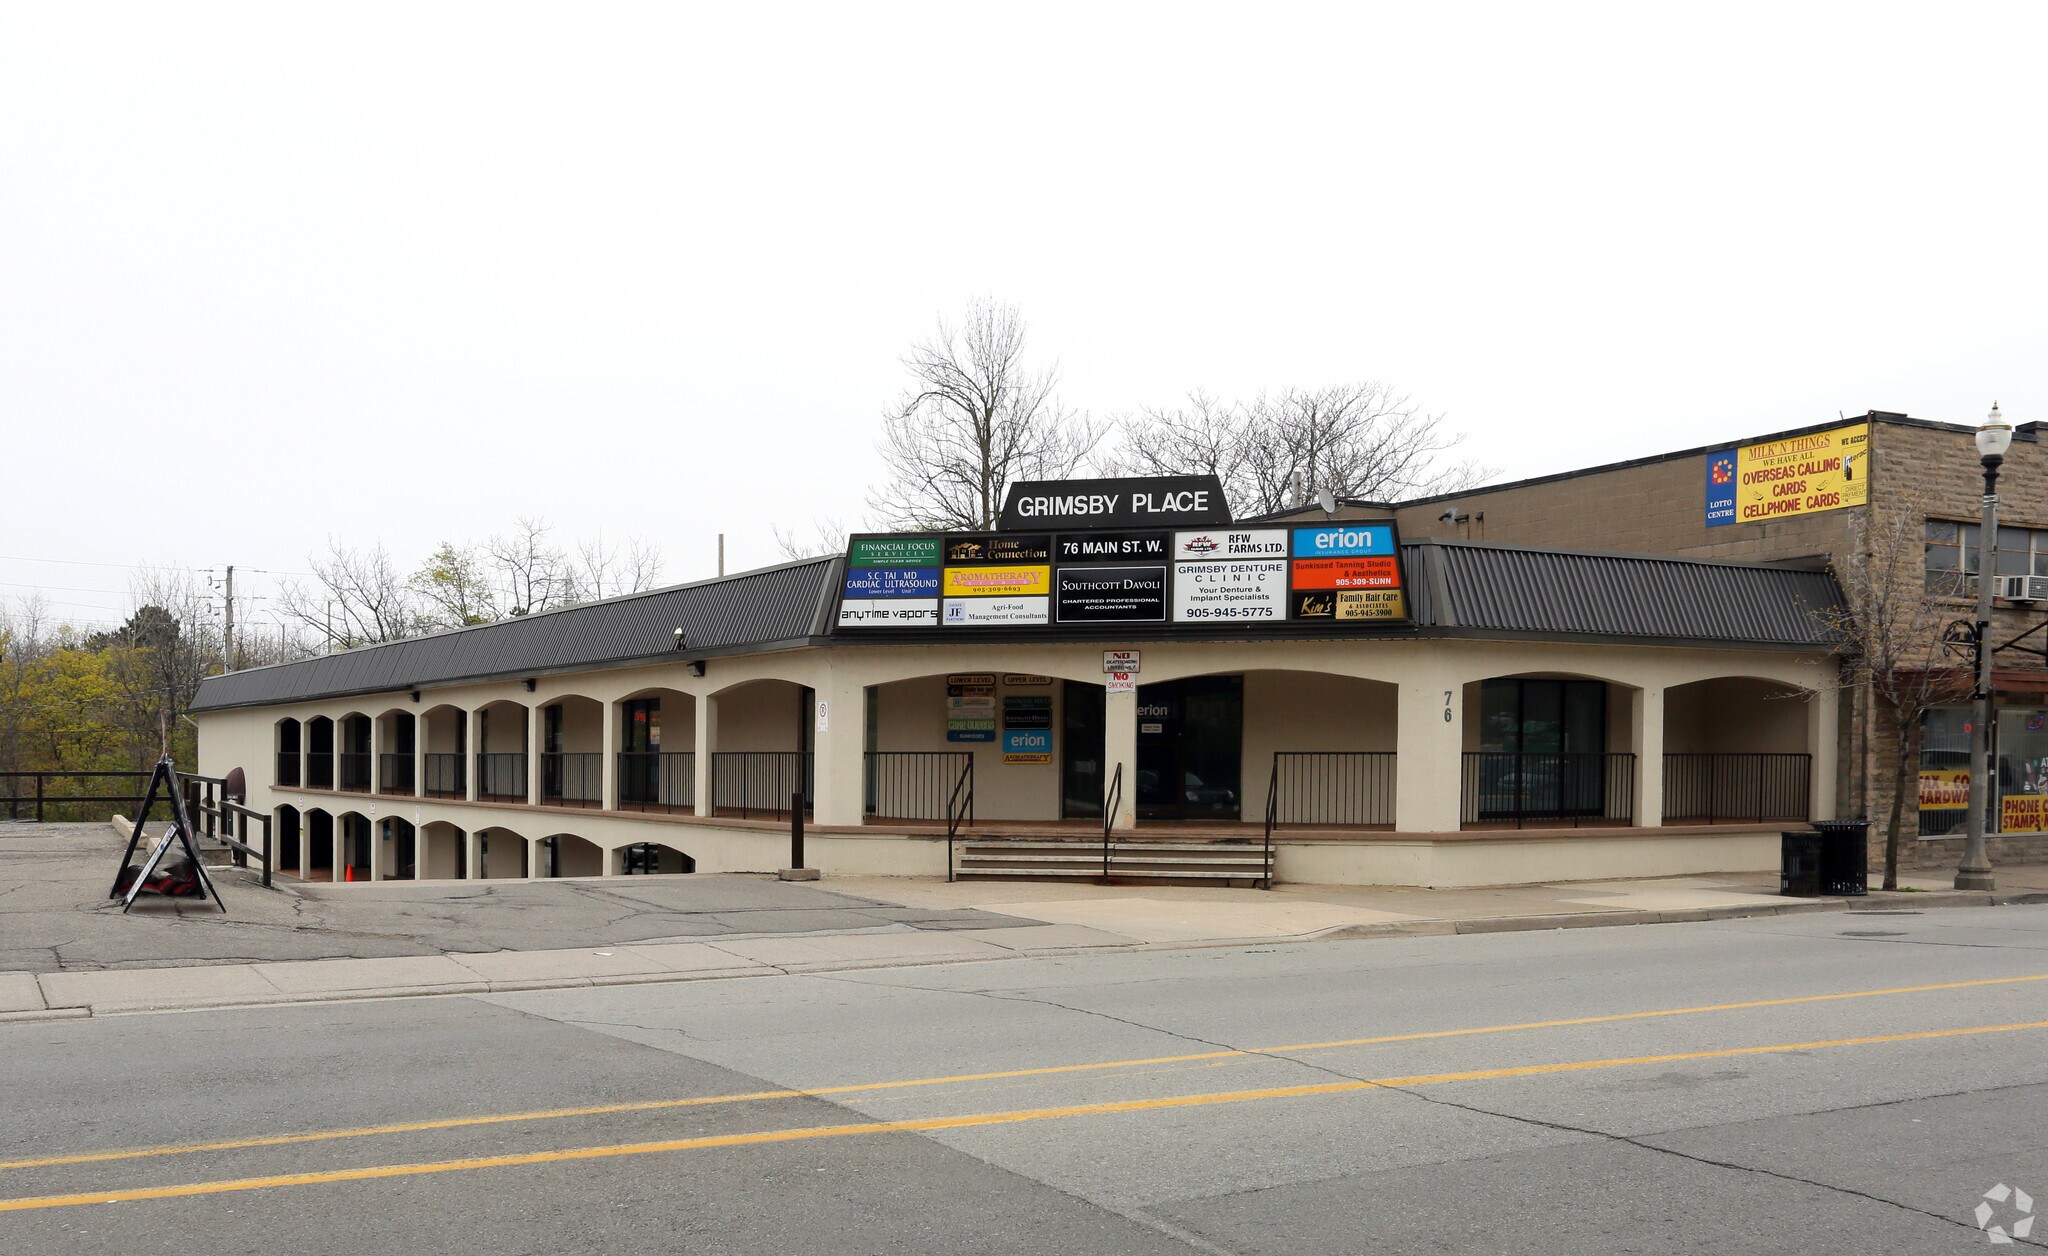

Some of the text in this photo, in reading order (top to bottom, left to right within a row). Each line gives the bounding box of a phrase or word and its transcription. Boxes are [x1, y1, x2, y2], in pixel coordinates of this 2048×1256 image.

[1790, 434, 1831, 452] THINGS
[1777, 455, 1798, 464] HAVE
[1800, 452, 1815, 460] ALL
[1743, 457, 1840, 485] OVERSEAS CALLING
[1773, 480, 1807, 497] CARDS
[1017, 491, 1208, 516] GRIMSBY PLACE
[1710, 499, 1732, 509] LOTTO
[1744, 492, 1840, 518] CELLPHONE CARDS
[1708, 509, 1734, 519] CENTRE
[1228, 534, 1251, 543] RFW
[1315, 528, 1371, 548] erion
[989, 540, 1019, 549] Home
[1063, 540, 1162, 554] 76 MAIN ST. W.
[1228, 543, 1285, 553] FARMS LTD.
[988, 549, 1047, 559] Connection
[1178, 564, 1282, 574] GRIMSBY DENTURE
[1195, 574, 1266, 582] CLINIC
[885, 580, 938, 588] ULTRASOUND
[1224, 594, 1270, 602] Specialists
[1340, 593, 1398, 603] Family Hair Care
[1301, 596, 1332, 614] Kim's
[893, 610, 938, 620] vapors
[949, 608, 962, 617] JF
[1186, 607, 1273, 618] 905-945-5775
[1346, 609, 1392, 617] 905-945-3900
[1113, 672, 1129, 680] NO
[1137, 704, 1168, 715] erion
[1011, 734, 1045, 746] erion
[1919, 790, 1969, 804] HARDWA
[2005, 800, 2040, 813] PHONE
